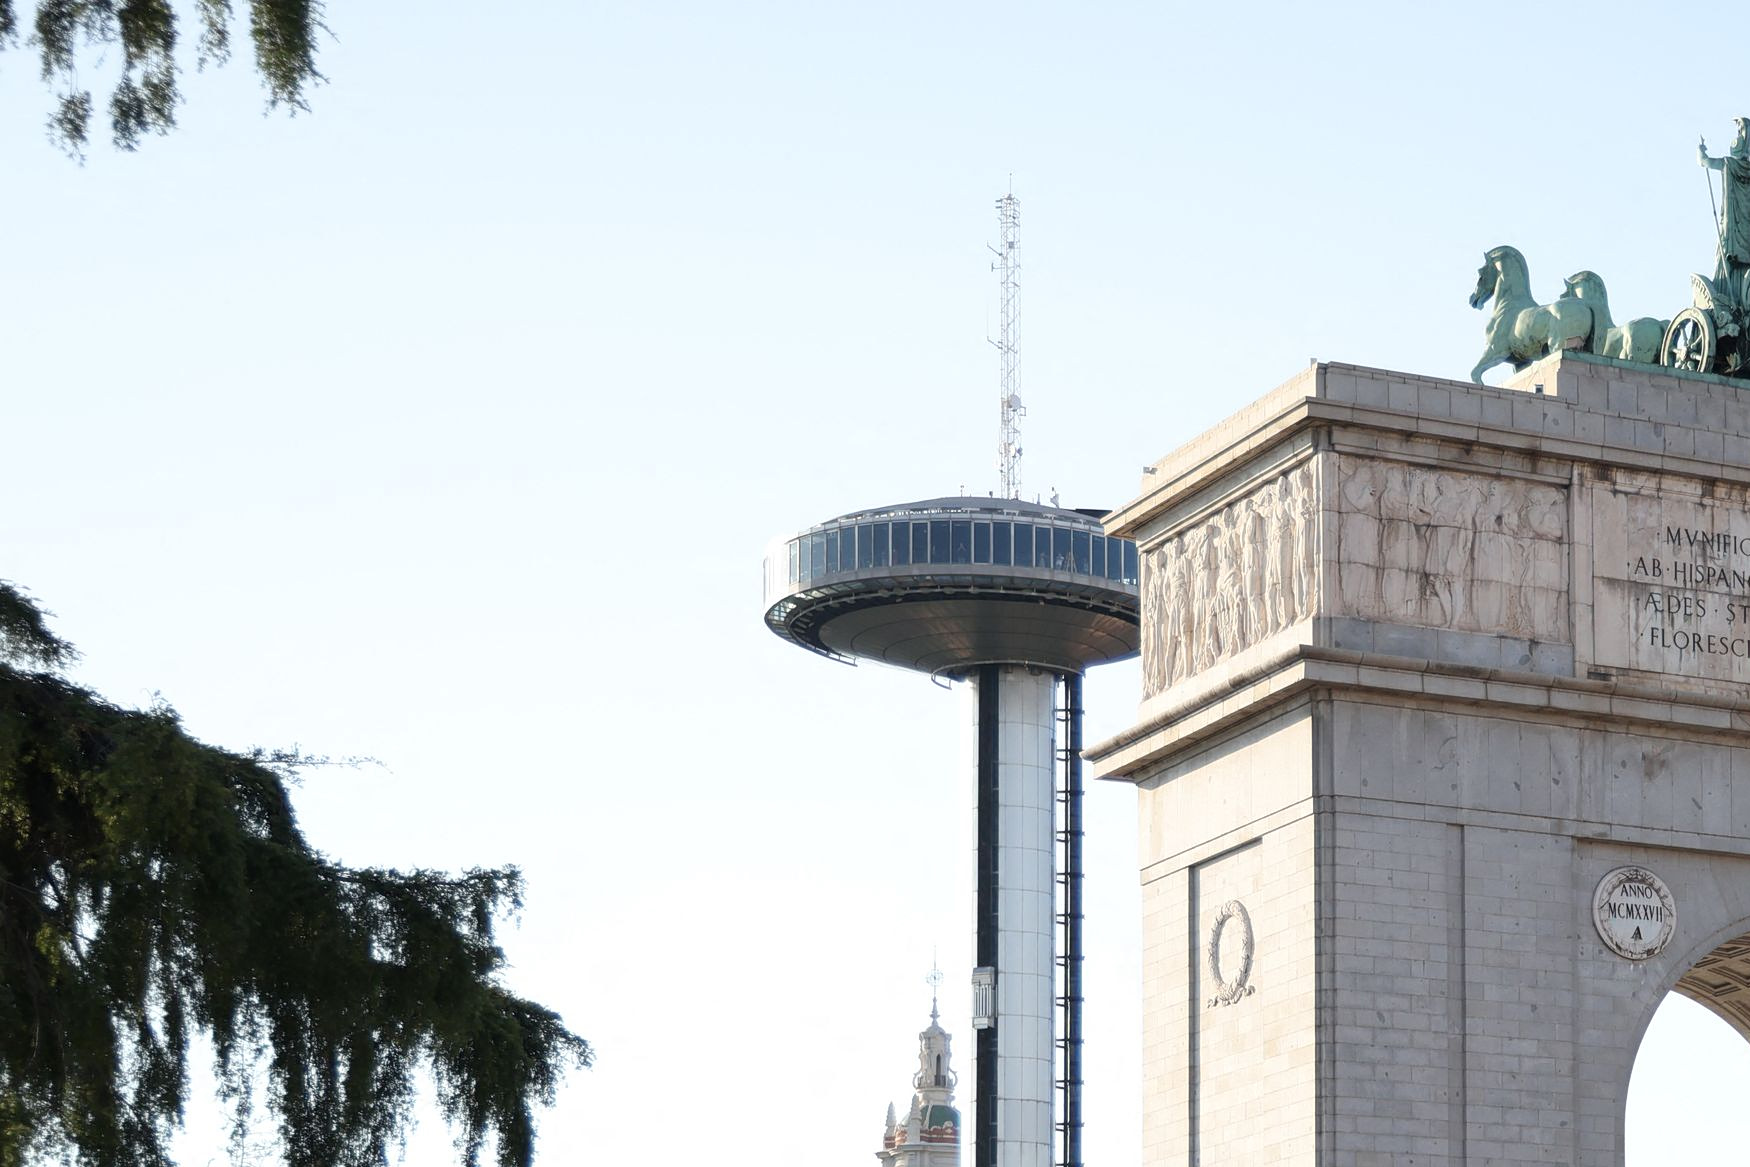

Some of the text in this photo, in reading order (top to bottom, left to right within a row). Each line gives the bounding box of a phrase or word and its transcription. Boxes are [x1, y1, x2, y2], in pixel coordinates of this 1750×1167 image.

[1635, 557, 1662, 577] AB
[1621, 884, 1652, 899] ANNO
[1608, 902, 1663, 923] MCMXXVII
